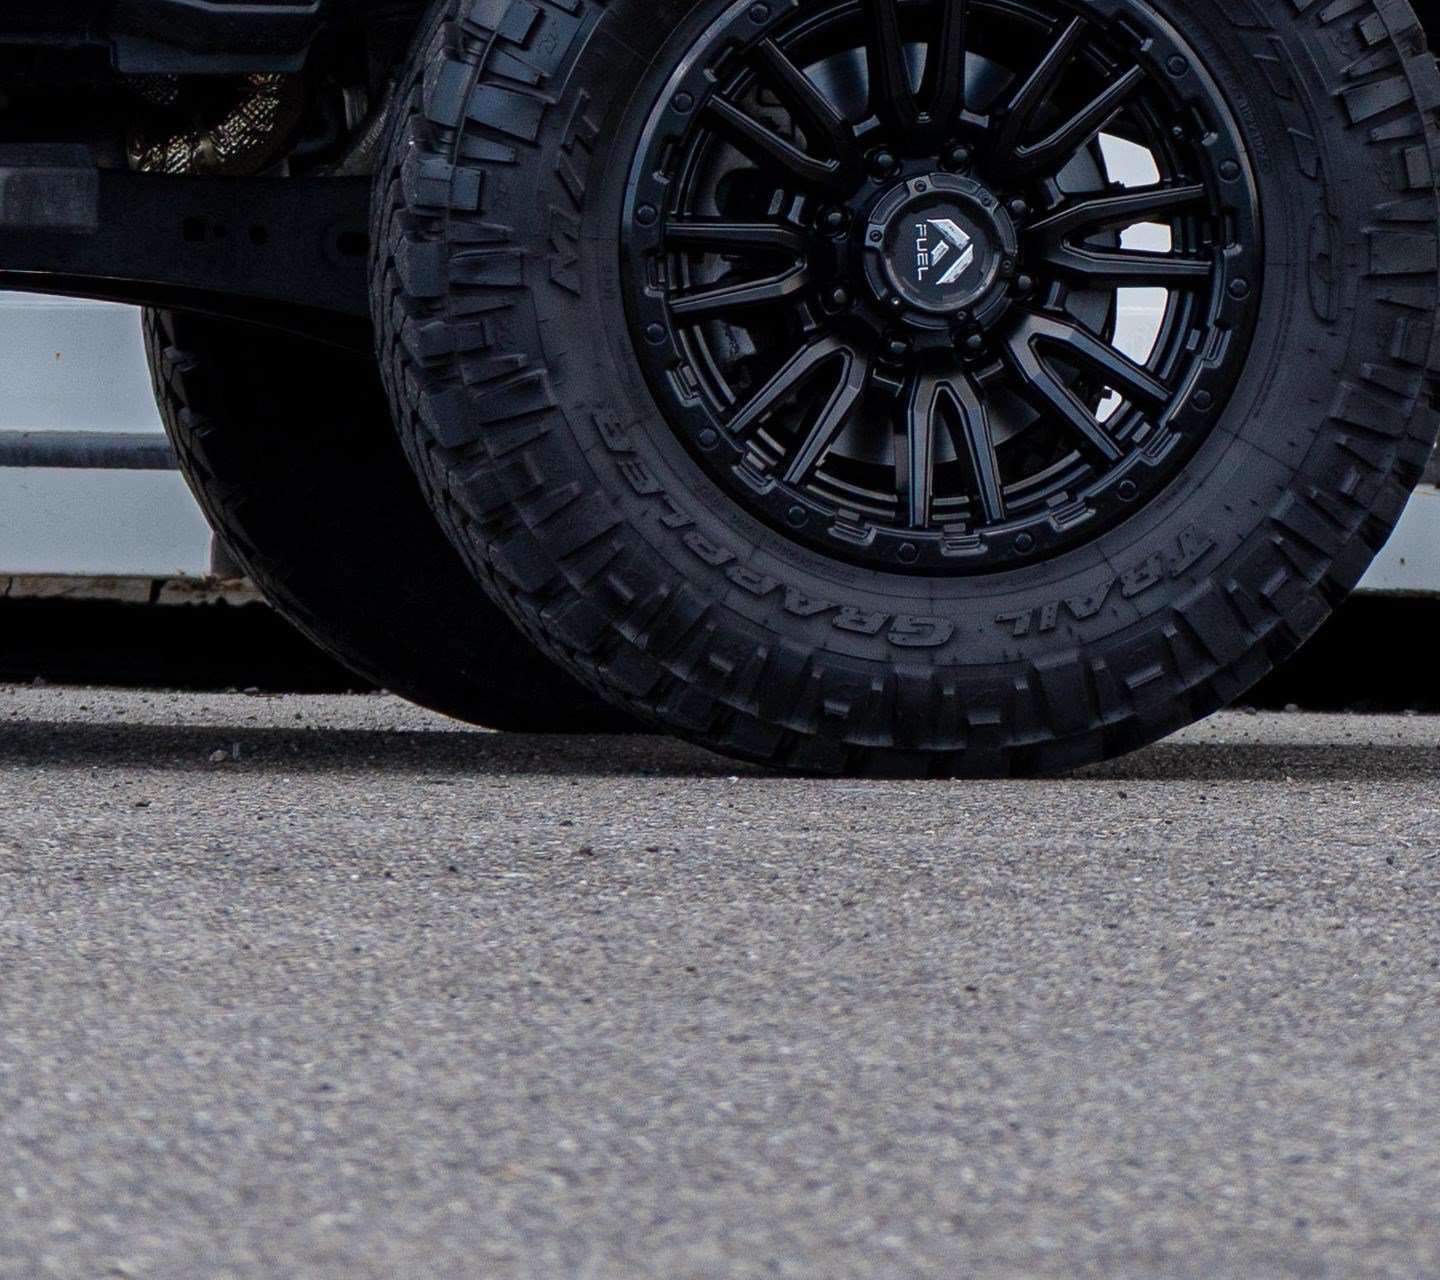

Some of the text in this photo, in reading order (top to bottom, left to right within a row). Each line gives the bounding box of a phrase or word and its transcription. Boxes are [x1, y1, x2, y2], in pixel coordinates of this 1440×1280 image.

[915, 223, 929, 281] FUEL
[592, 410, 955, 646] GRAPPLER
[995, 524, 1214, 637] TRAIL
